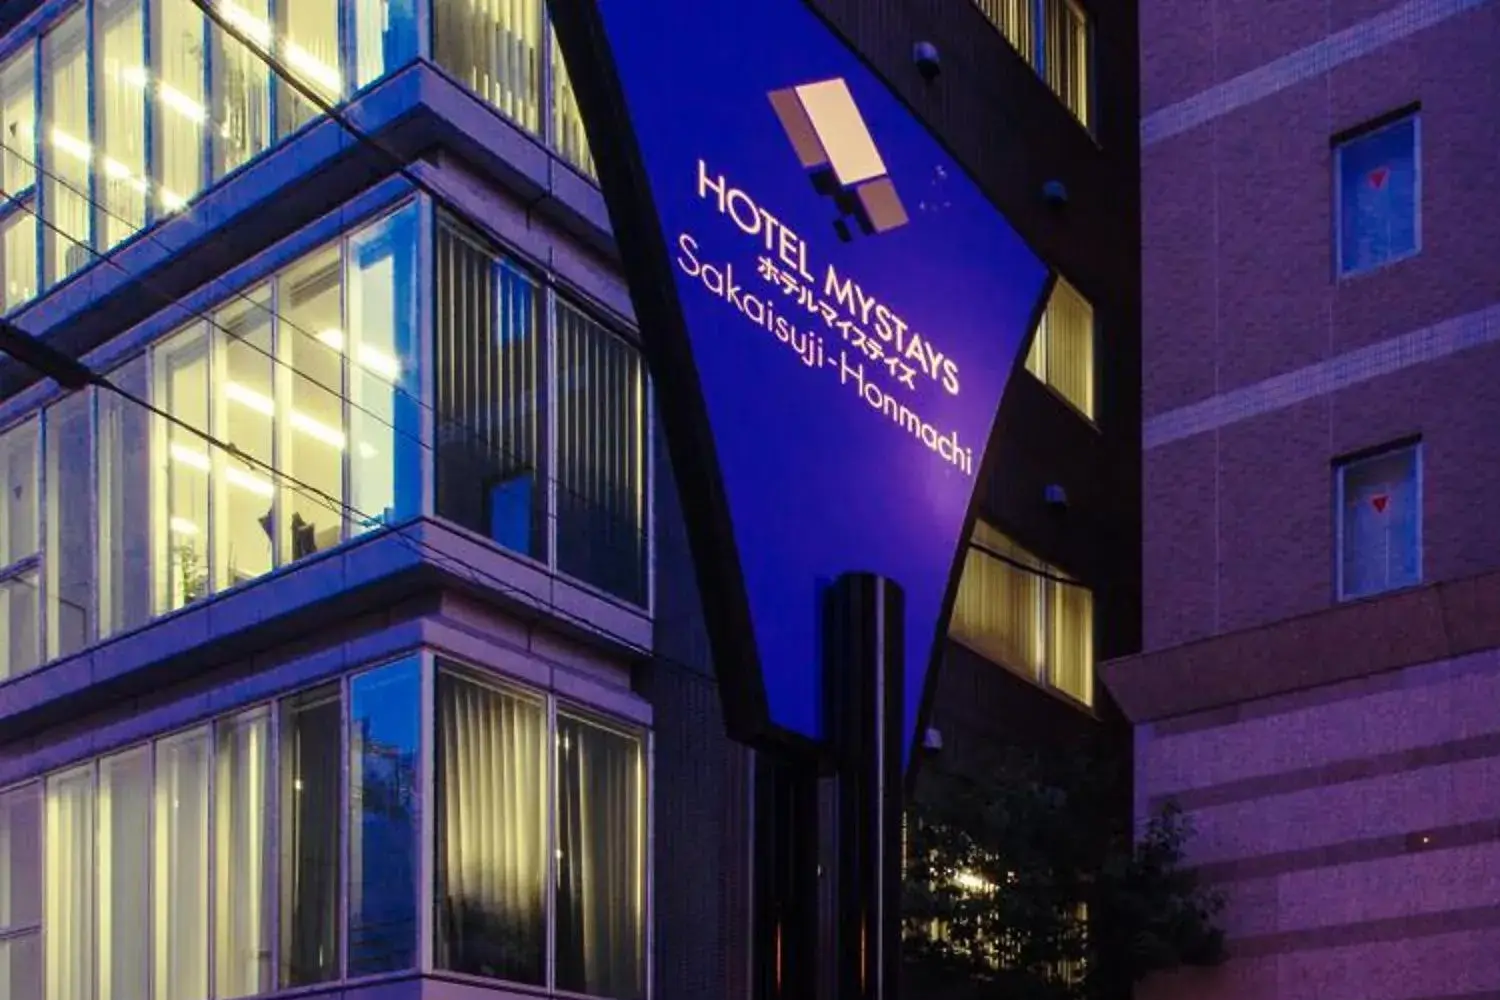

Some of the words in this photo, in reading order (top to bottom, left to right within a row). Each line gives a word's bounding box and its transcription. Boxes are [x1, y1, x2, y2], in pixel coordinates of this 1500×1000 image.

[698, 159, 815, 283] HOTEL
[824, 264, 960, 397] MYSTAYS
[757, 255, 917, 390] ホテルマイステイズ
